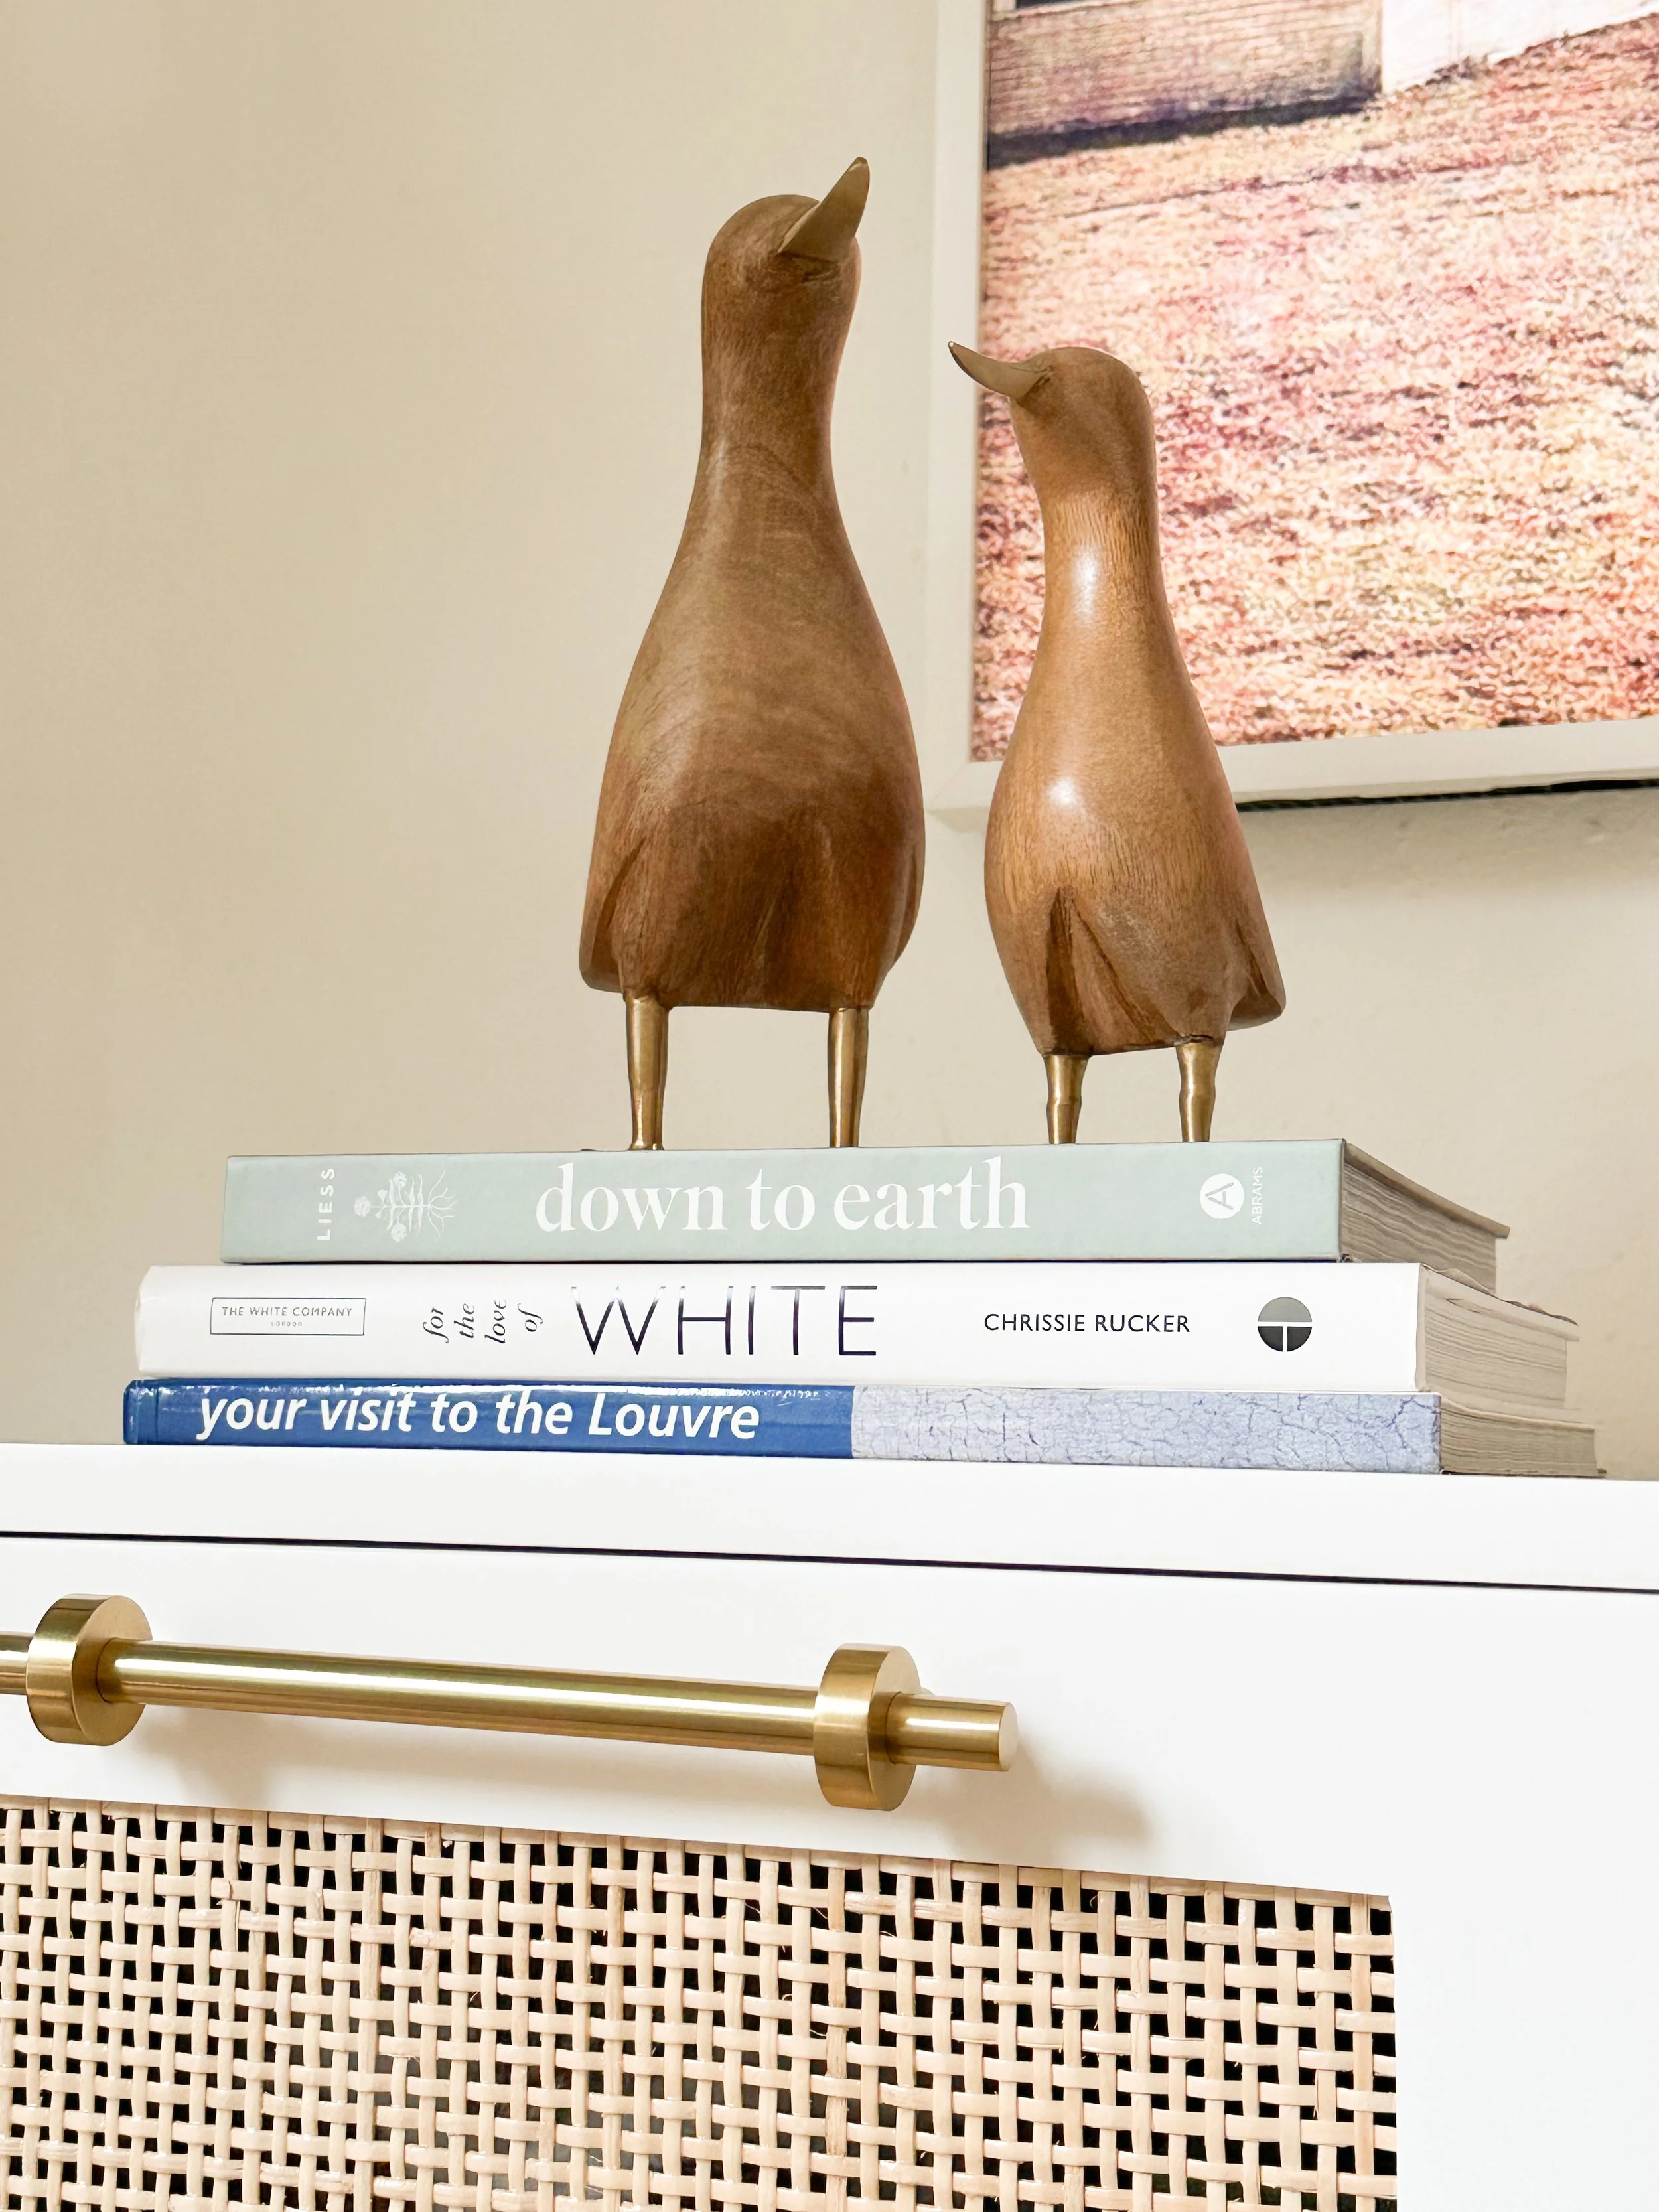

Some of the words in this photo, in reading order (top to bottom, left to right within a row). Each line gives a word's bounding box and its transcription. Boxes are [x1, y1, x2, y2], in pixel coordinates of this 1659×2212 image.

[317, 1168, 335, 1240] LIESS
[536, 1162, 726, 1232] down
[746, 1167, 816, 1231] to
[834, 1155, 1030, 1230] earth
[1252, 1166, 1263, 1225] ABRAMS
[222, 1306, 244, 1316] THE
[250, 1306, 287, 1317] WHITE
[292, 1306, 353, 1317] COMPANY
[423, 1307, 449, 1344] for
[453, 1303, 475, 1339] the
[484, 1299, 507, 1344] love
[517, 1302, 543, 1332] of
[571, 1284, 878, 1356] WHITE
[984, 1313, 1085, 1331] CHRISSIE
[1096, 1315, 1190, 1333] RUCKER
[196, 1396, 307, 1440] your
[320, 1386, 417, 1432] visit
[430, 1394, 478, 1433] to
[495, 1388, 573, 1435] the
[588, 1392, 760, 1439] Louvre
